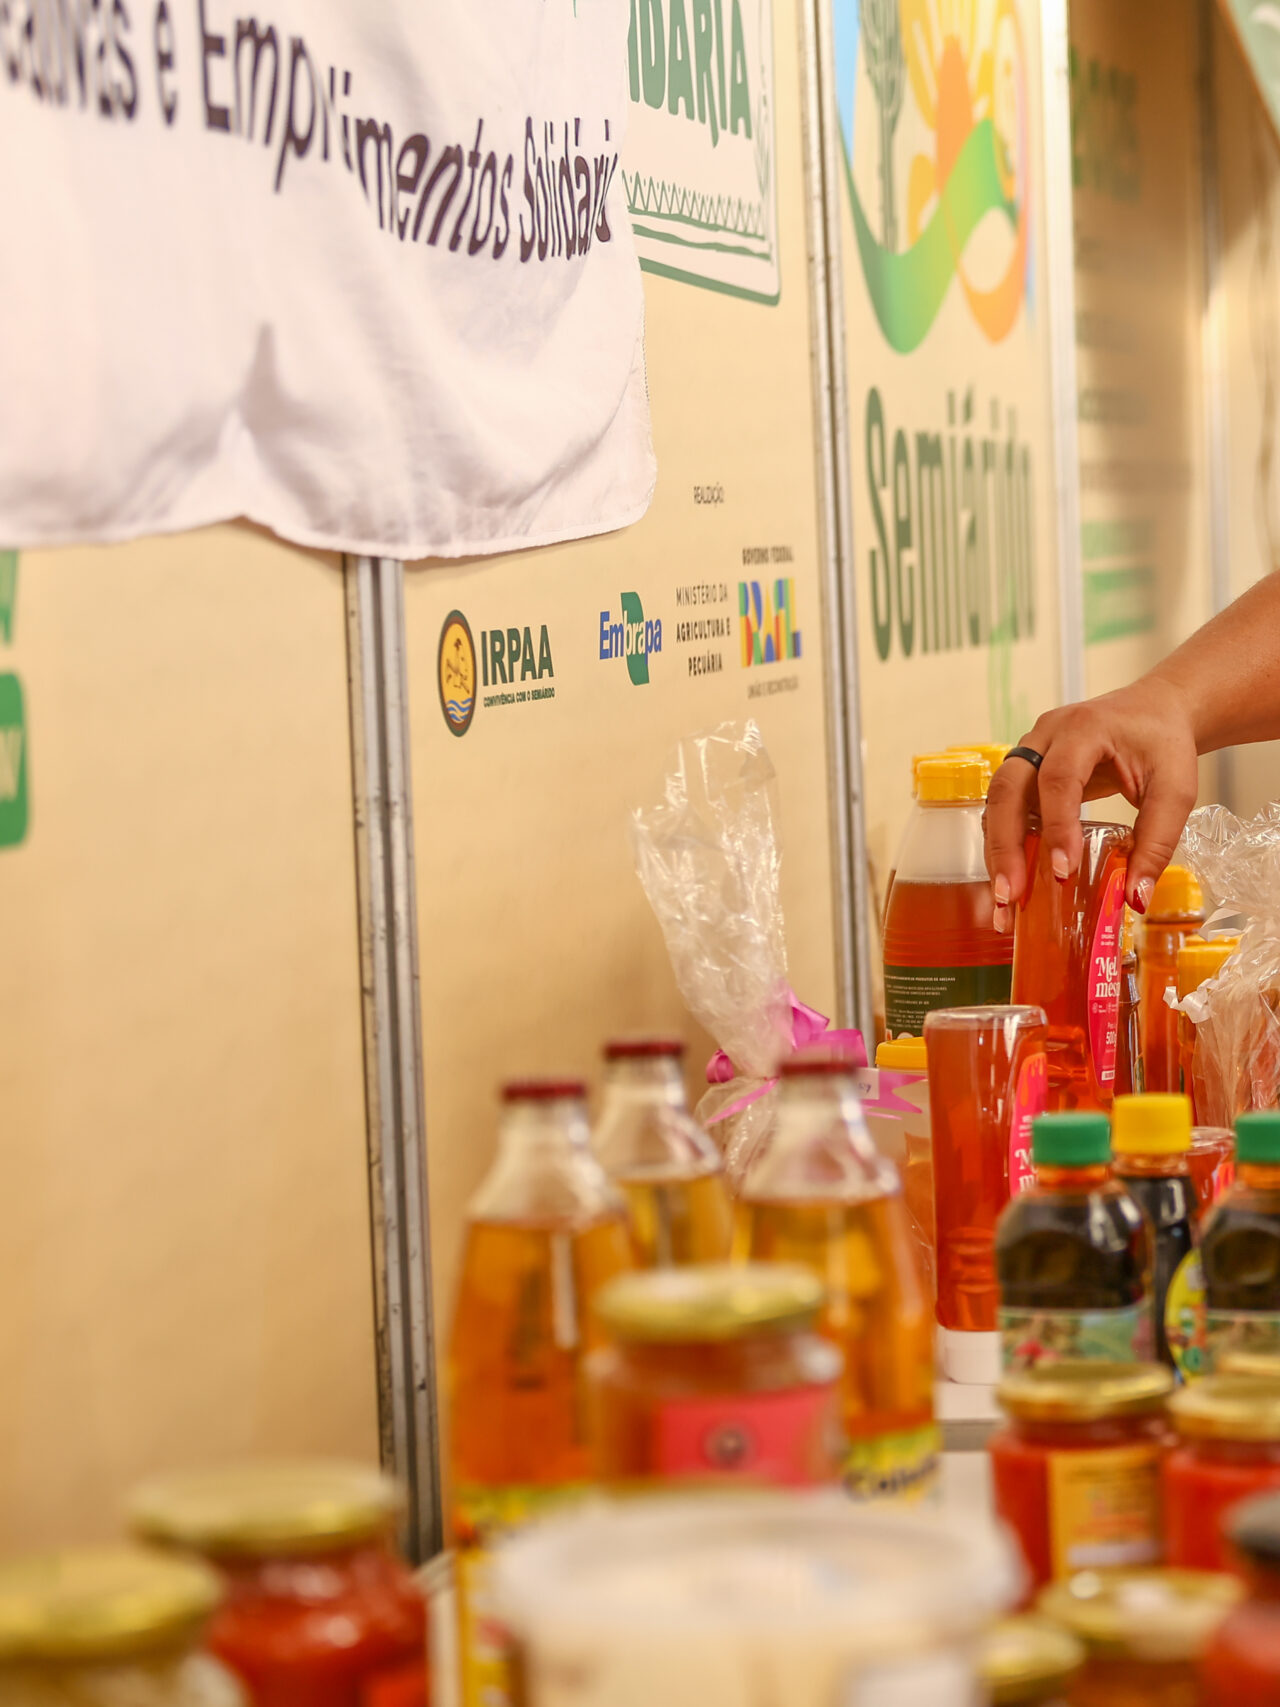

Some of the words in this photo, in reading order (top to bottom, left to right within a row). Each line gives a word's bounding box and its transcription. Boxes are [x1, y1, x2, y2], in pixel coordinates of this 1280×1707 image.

[153, 0, 178, 126] e
[865, 385, 1034, 664] Semiárido
[676, 581, 717, 606] MINISTÉRIO
[719, 583, 728, 602] DA
[481, 625, 554, 687] IRPAA
[600, 610, 662, 664] Embrapa
[676, 618, 724, 643] AGRICULTURA
[726, 617, 731, 636] E
[688, 650, 722, 677] PECUÁRIA
